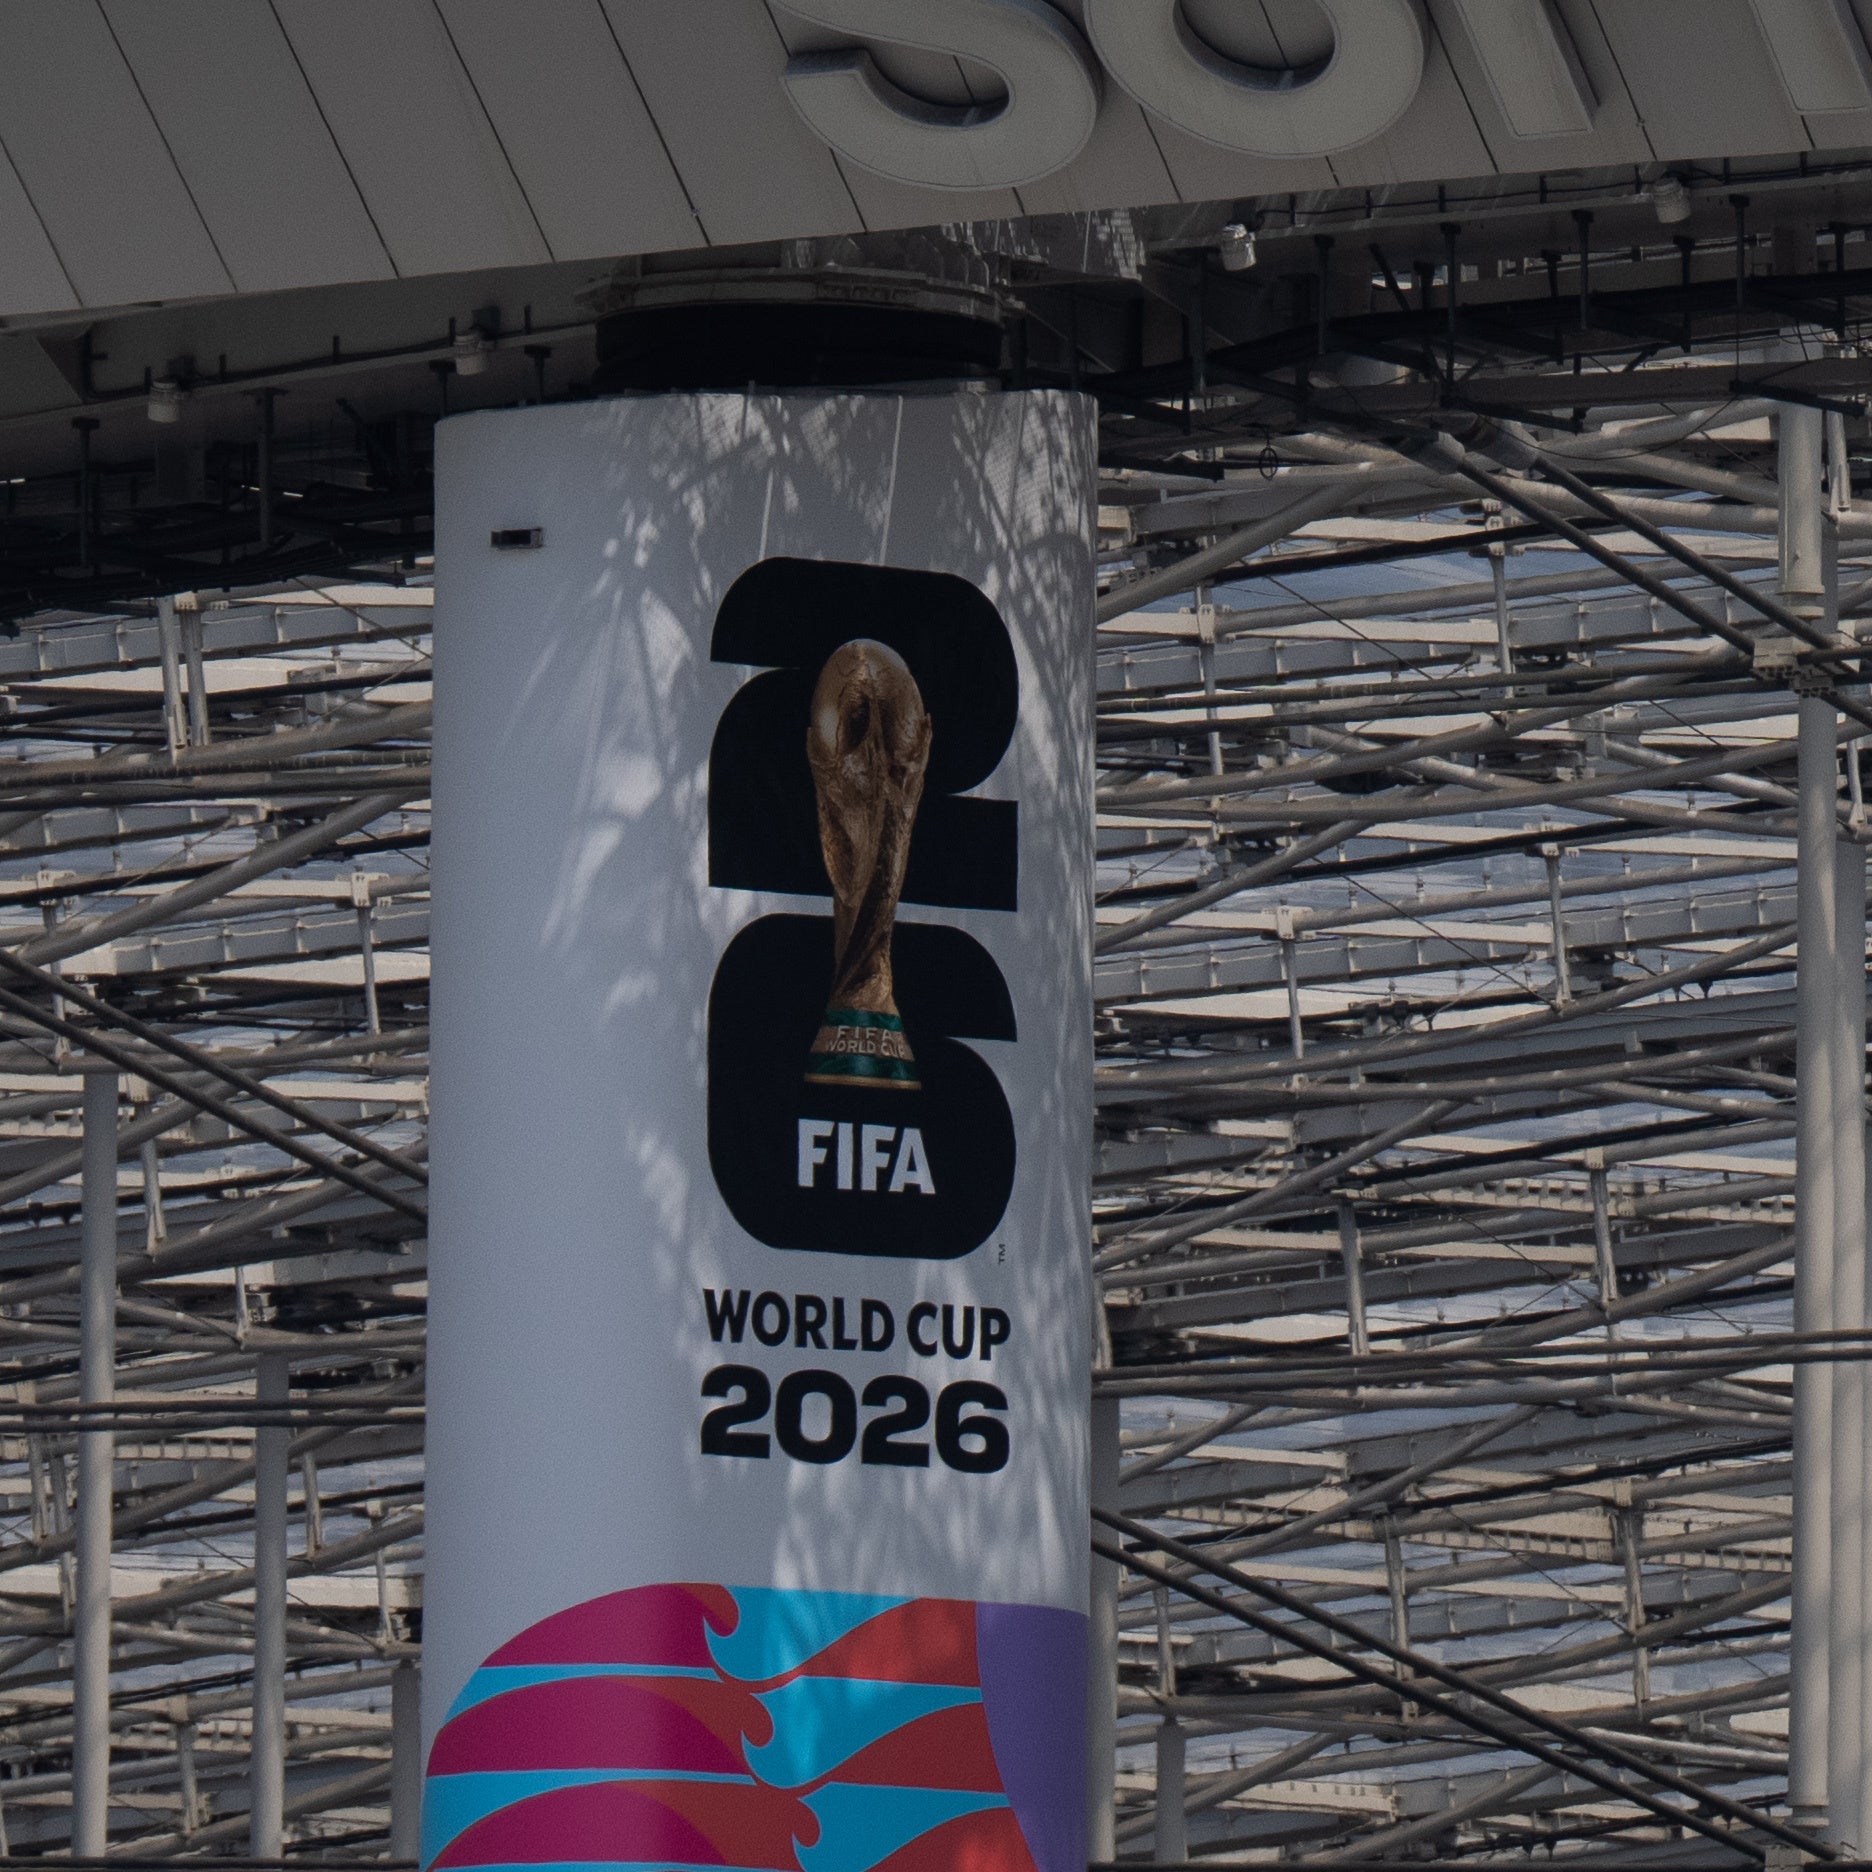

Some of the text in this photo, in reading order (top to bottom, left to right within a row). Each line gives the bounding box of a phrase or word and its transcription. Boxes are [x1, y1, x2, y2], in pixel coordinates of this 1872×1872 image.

[837, 1025, 893, 1041] FIFA
[880, 1042, 905, 1058] CUP
[797, 1118, 936, 1195] FIFA
[703, 1288, 1011, 1361] WORLD CUP
[700, 1364, 1010, 1474] 2026
